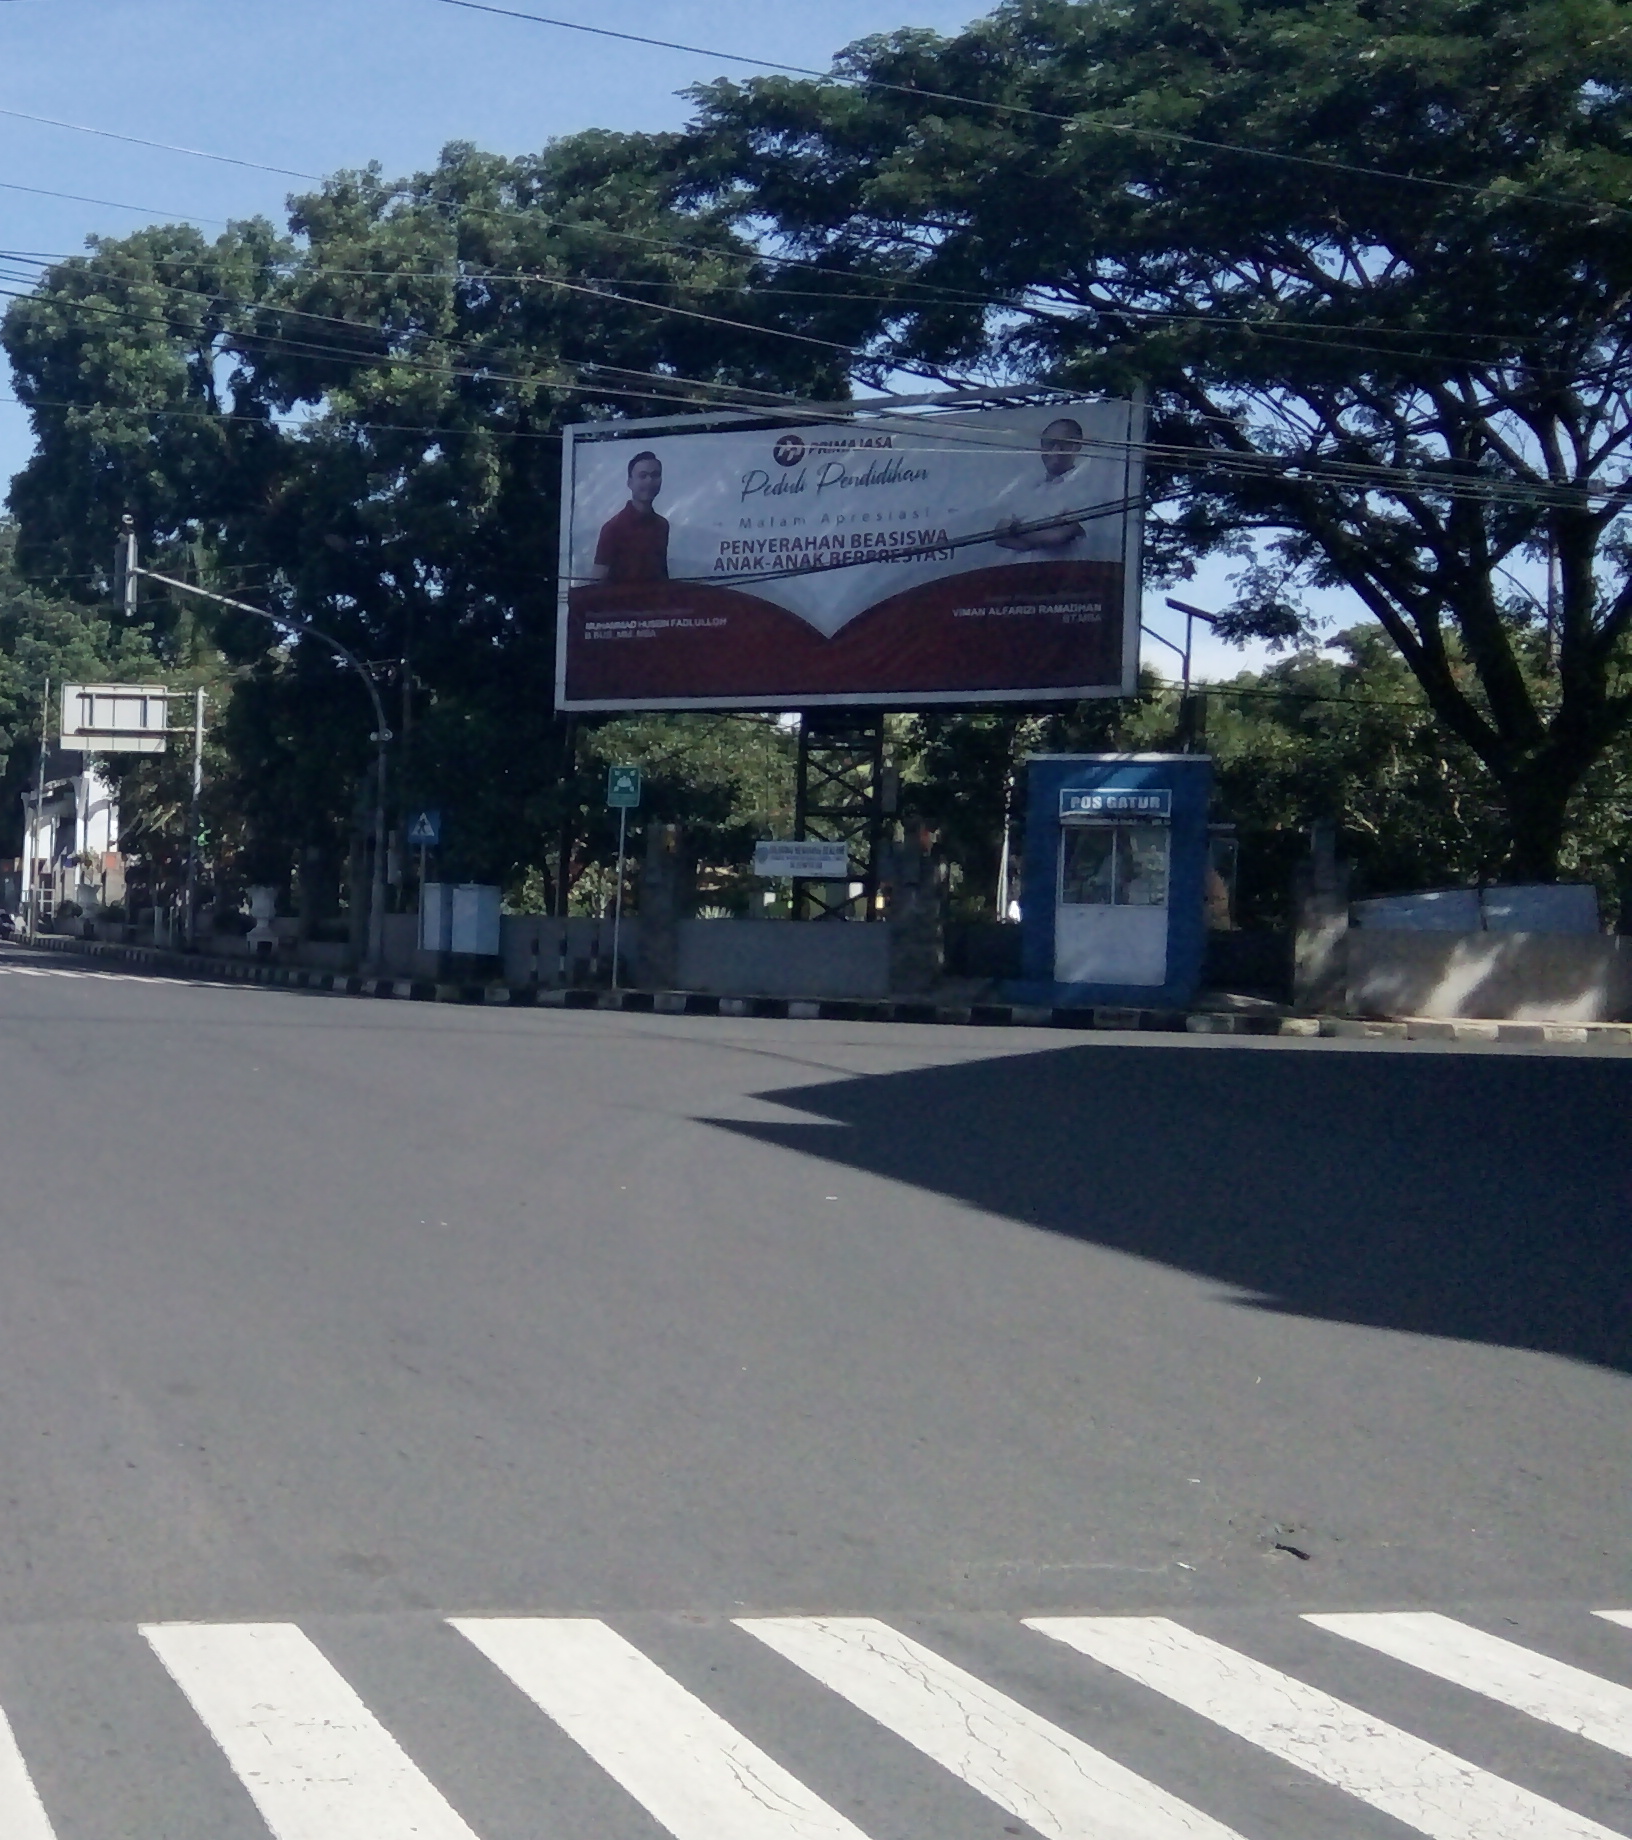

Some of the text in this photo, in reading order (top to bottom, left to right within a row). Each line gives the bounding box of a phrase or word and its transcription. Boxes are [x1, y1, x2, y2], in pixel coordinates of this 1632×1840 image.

[741, 456, 929, 503] Peduli Pendidikan
[738, 509, 931, 529] Malam Apresiasi
[720, 528, 949, 555] PENYERAHAN BEASISWA
[713, 547, 956, 572] ANAK-ANAK BERPRESTASI
[1070, 796, 1161, 809] POS GATUR
